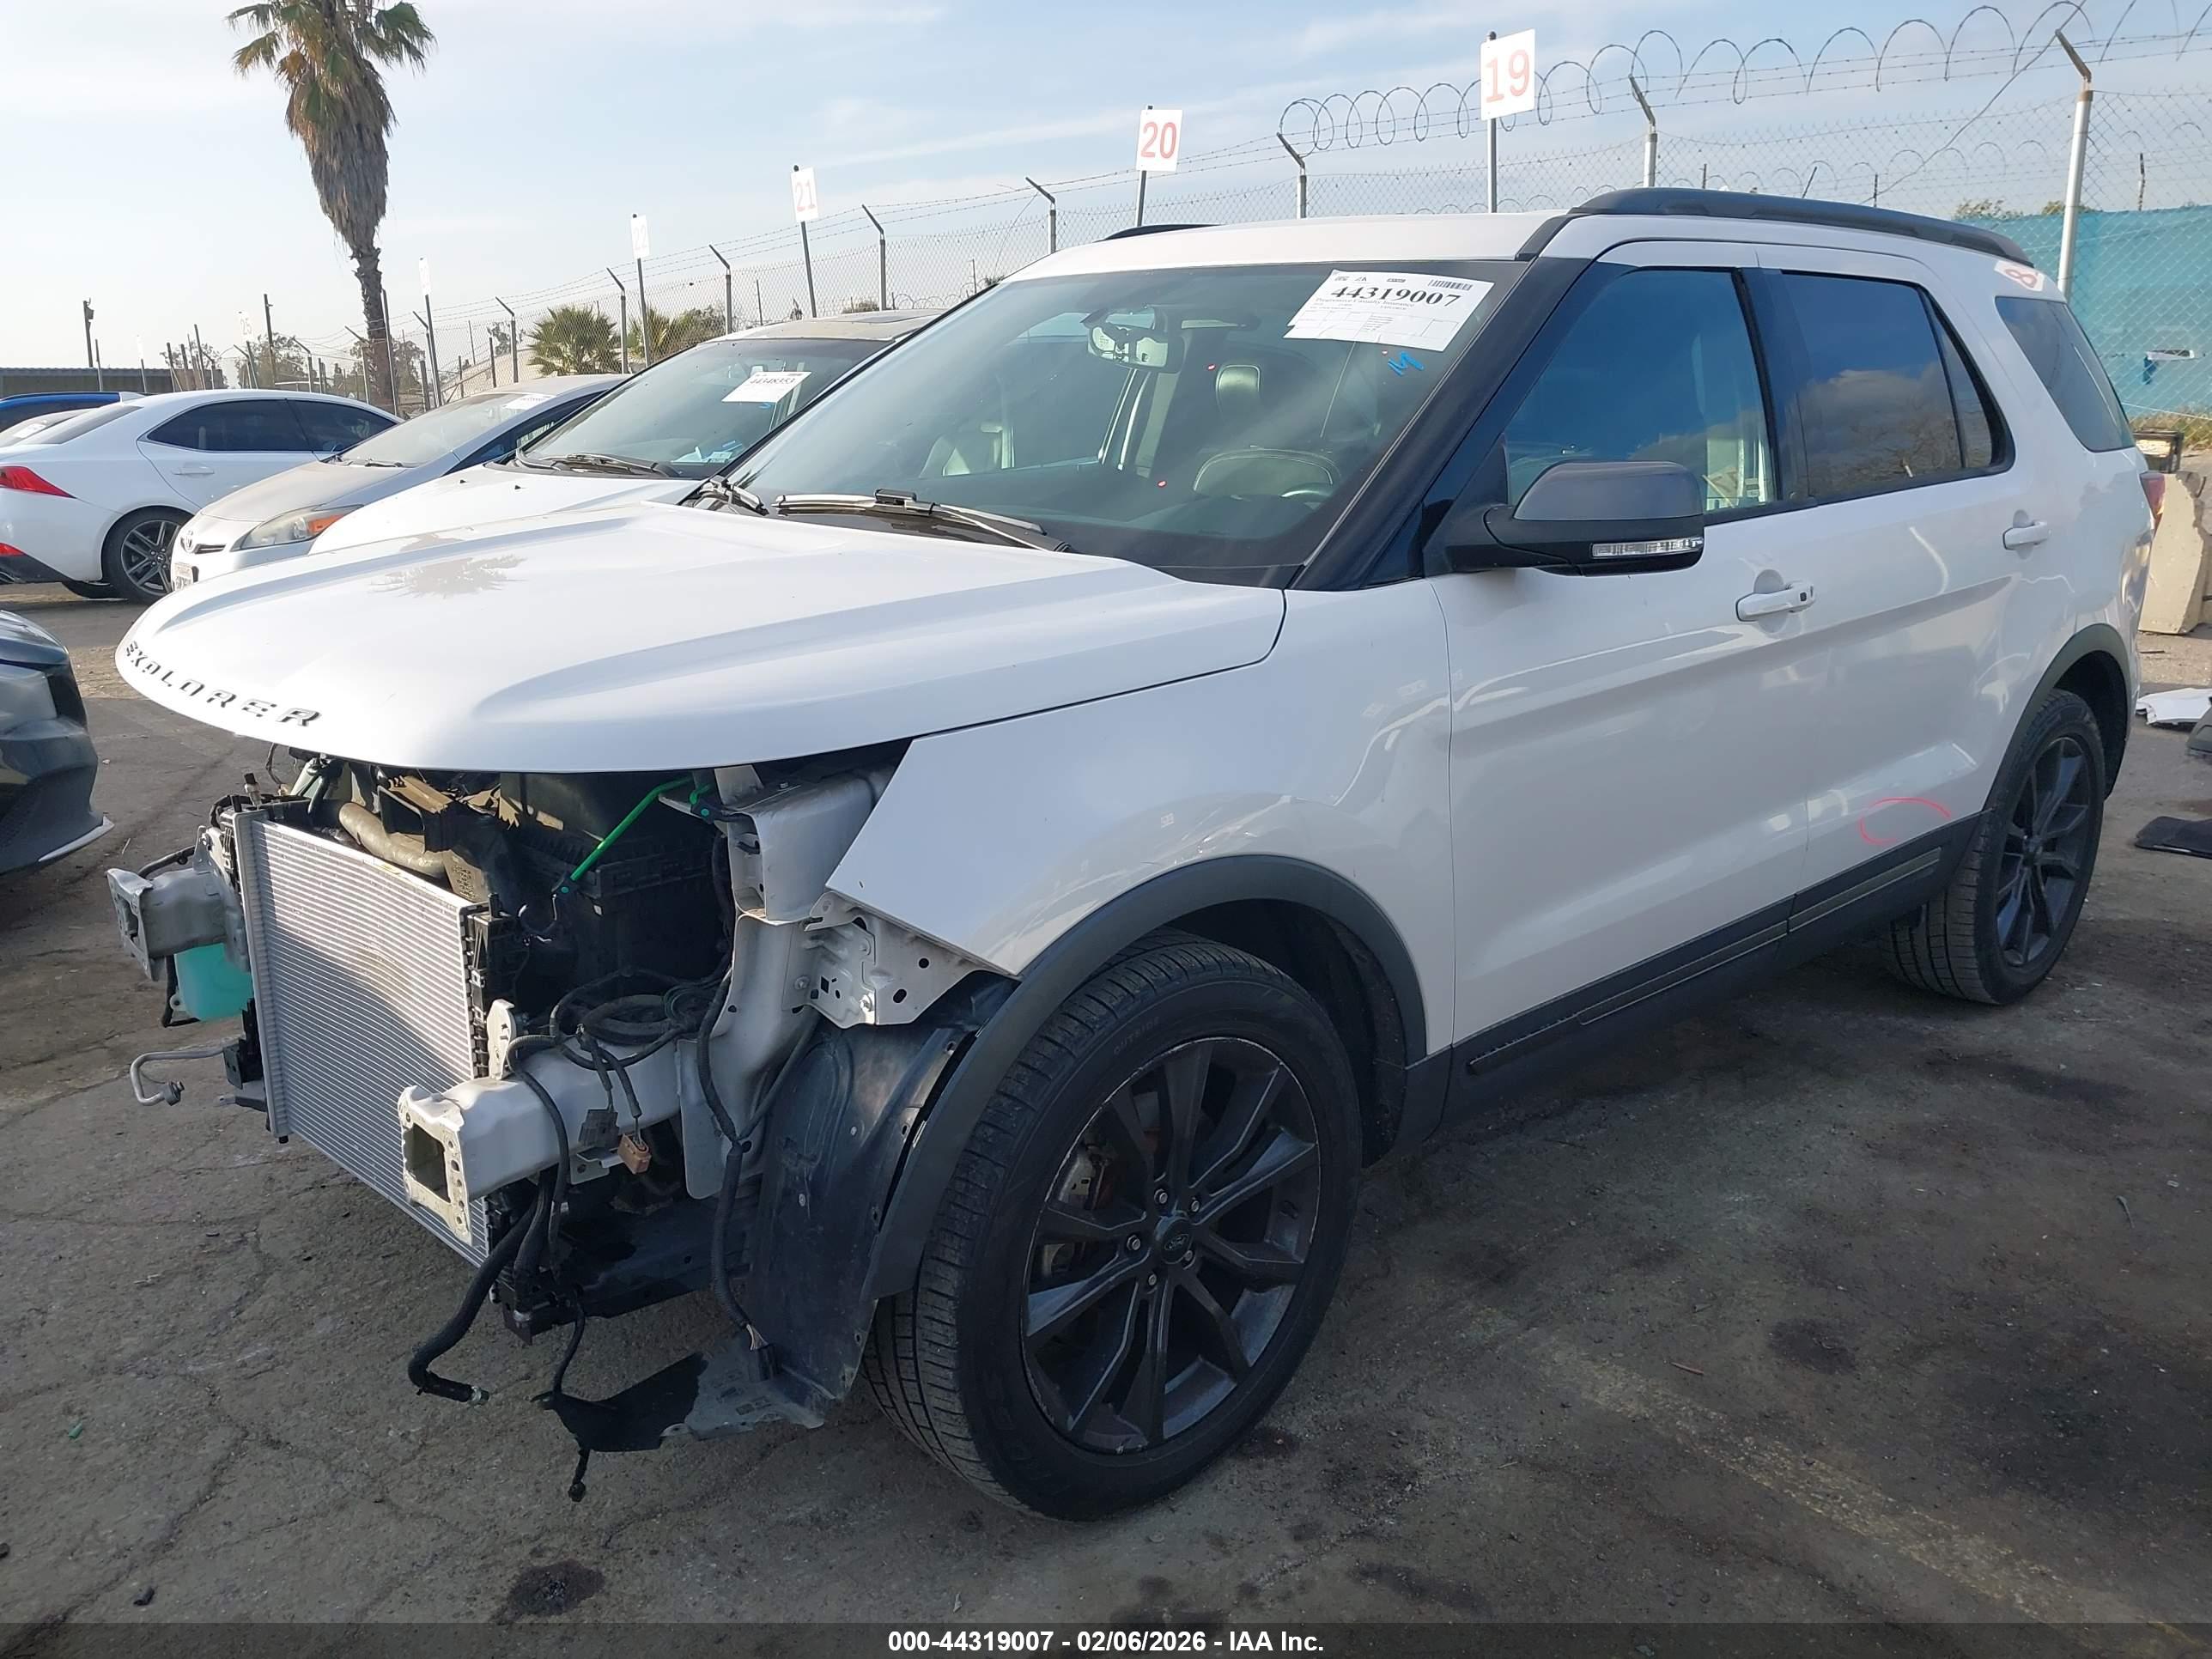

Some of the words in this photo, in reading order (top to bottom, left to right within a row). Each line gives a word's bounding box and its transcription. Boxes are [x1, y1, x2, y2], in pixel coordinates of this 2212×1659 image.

[1485, 48, 1531, 104] 19
[1141, 120, 1179, 159] 20
[794, 179, 817, 212] 21
[632, 224, 647, 251] 22
[1331, 286, 1462, 307] 44319007
[240, 318, 252, 335] 25
[125, 641, 323, 727] EXPLORER
